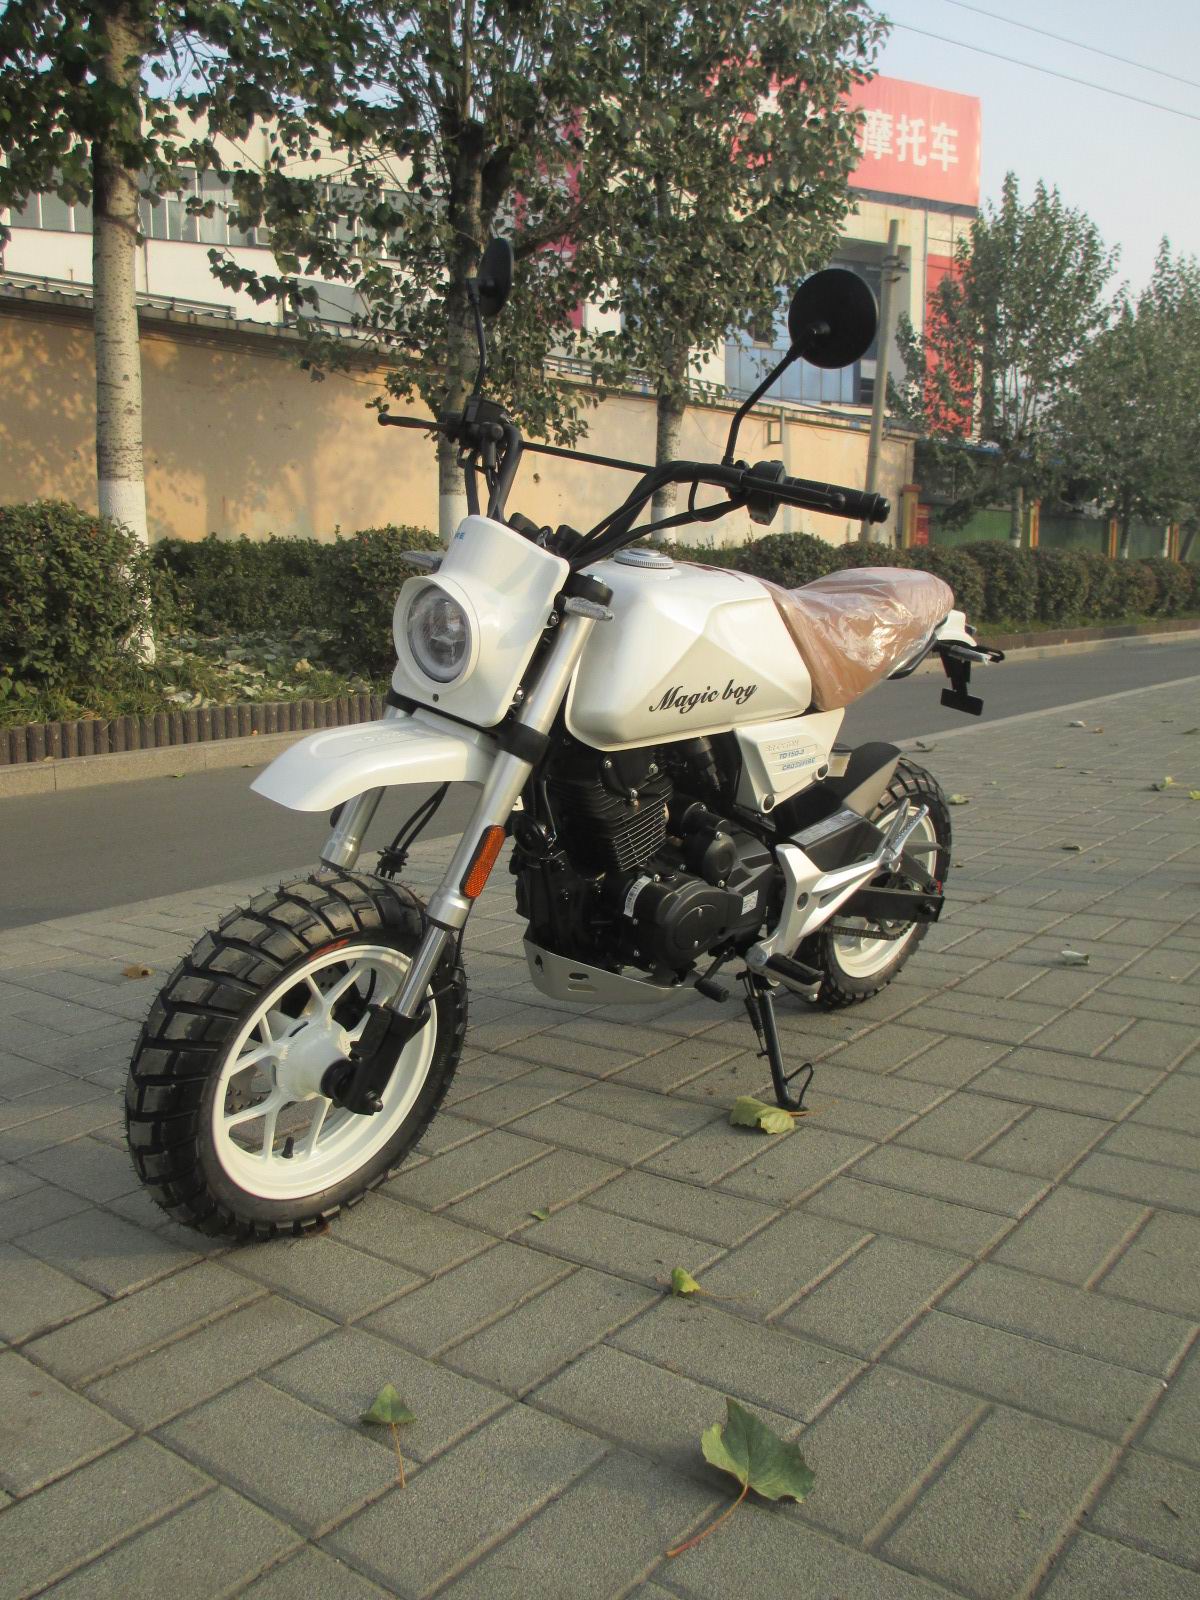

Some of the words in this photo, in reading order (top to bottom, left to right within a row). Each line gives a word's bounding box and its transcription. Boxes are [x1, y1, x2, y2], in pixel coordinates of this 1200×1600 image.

[862, 109, 959, 172] 摩托车
[648, 685, 719, 714] Magic
[722, 678, 758, 705] boy
